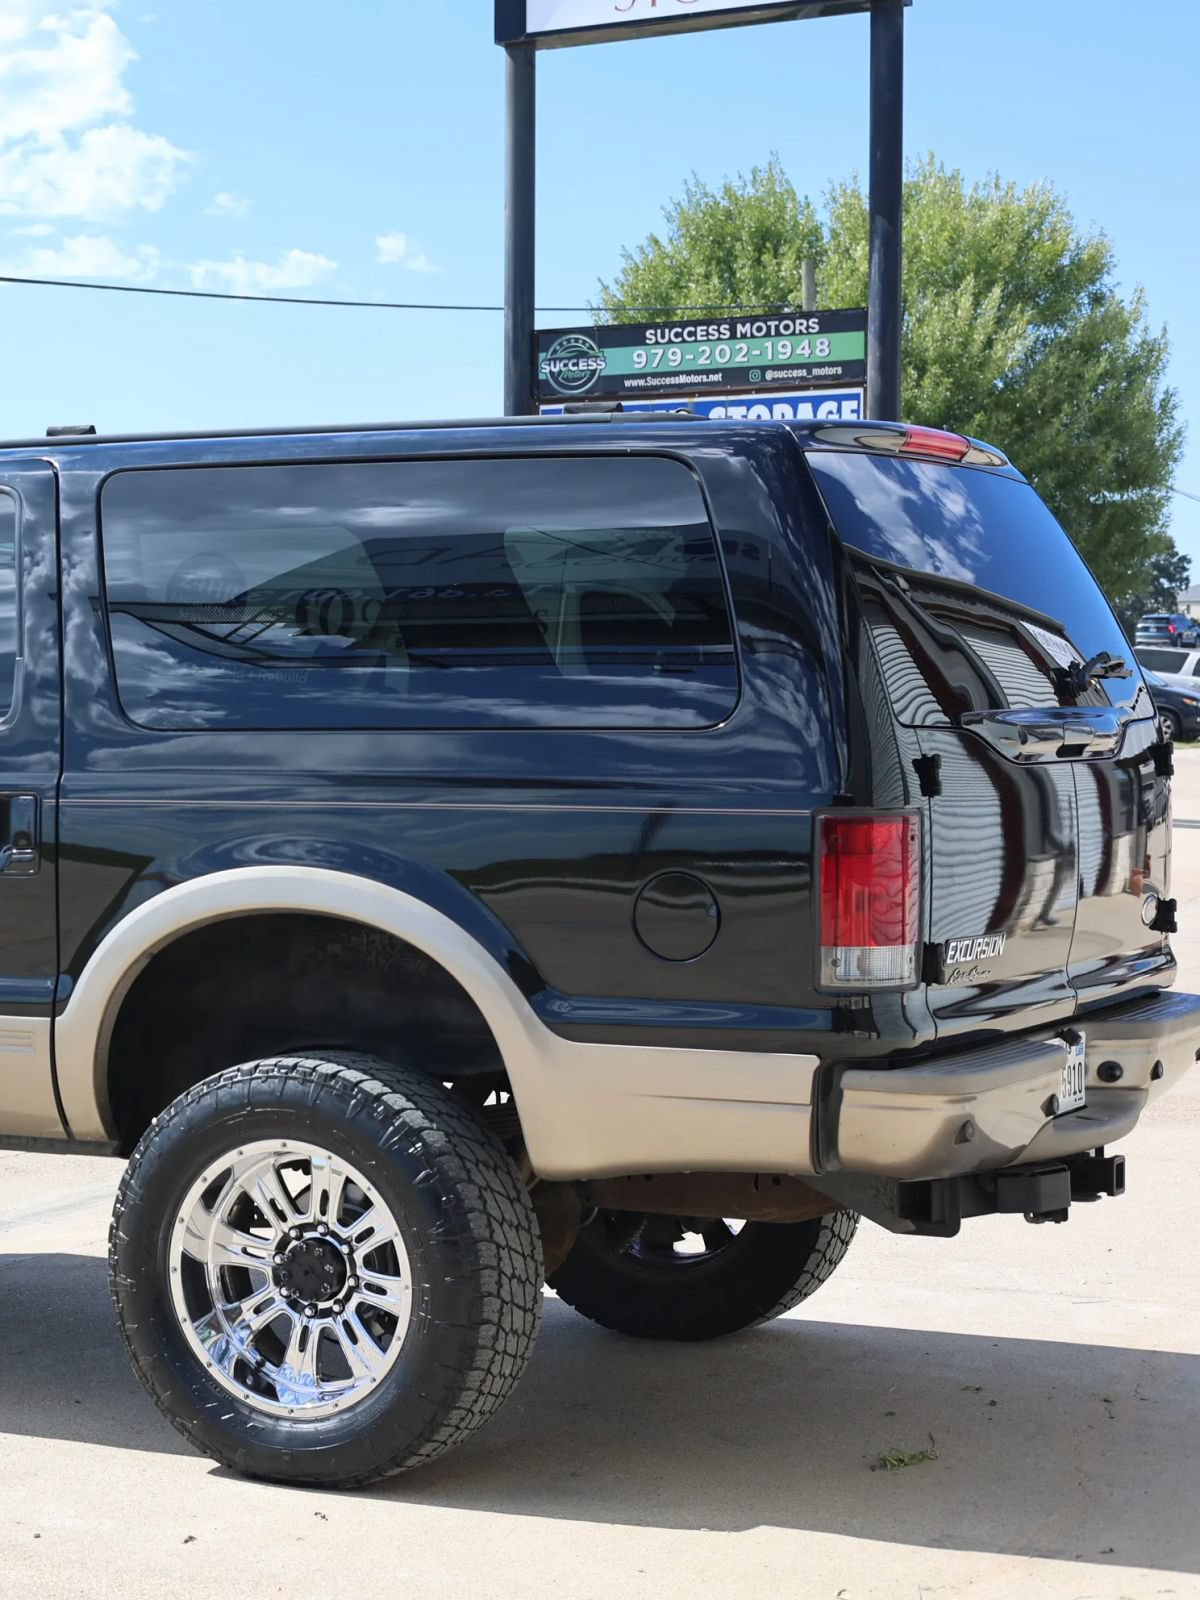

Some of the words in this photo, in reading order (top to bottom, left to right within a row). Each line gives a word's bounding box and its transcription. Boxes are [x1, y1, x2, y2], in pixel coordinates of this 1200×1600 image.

[645, 324, 731, 344] SUCCESS
[736, 318, 820, 338] MOTORS
[632, 338, 831, 370] 979-202-1948
[540, 357, 606, 374] SUCCESS
[765, 366, 843, 382] @success_motors
[624, 372, 723, 388] www.SuccessMotors.net
[946, 934, 1007, 964] EXCURSION
